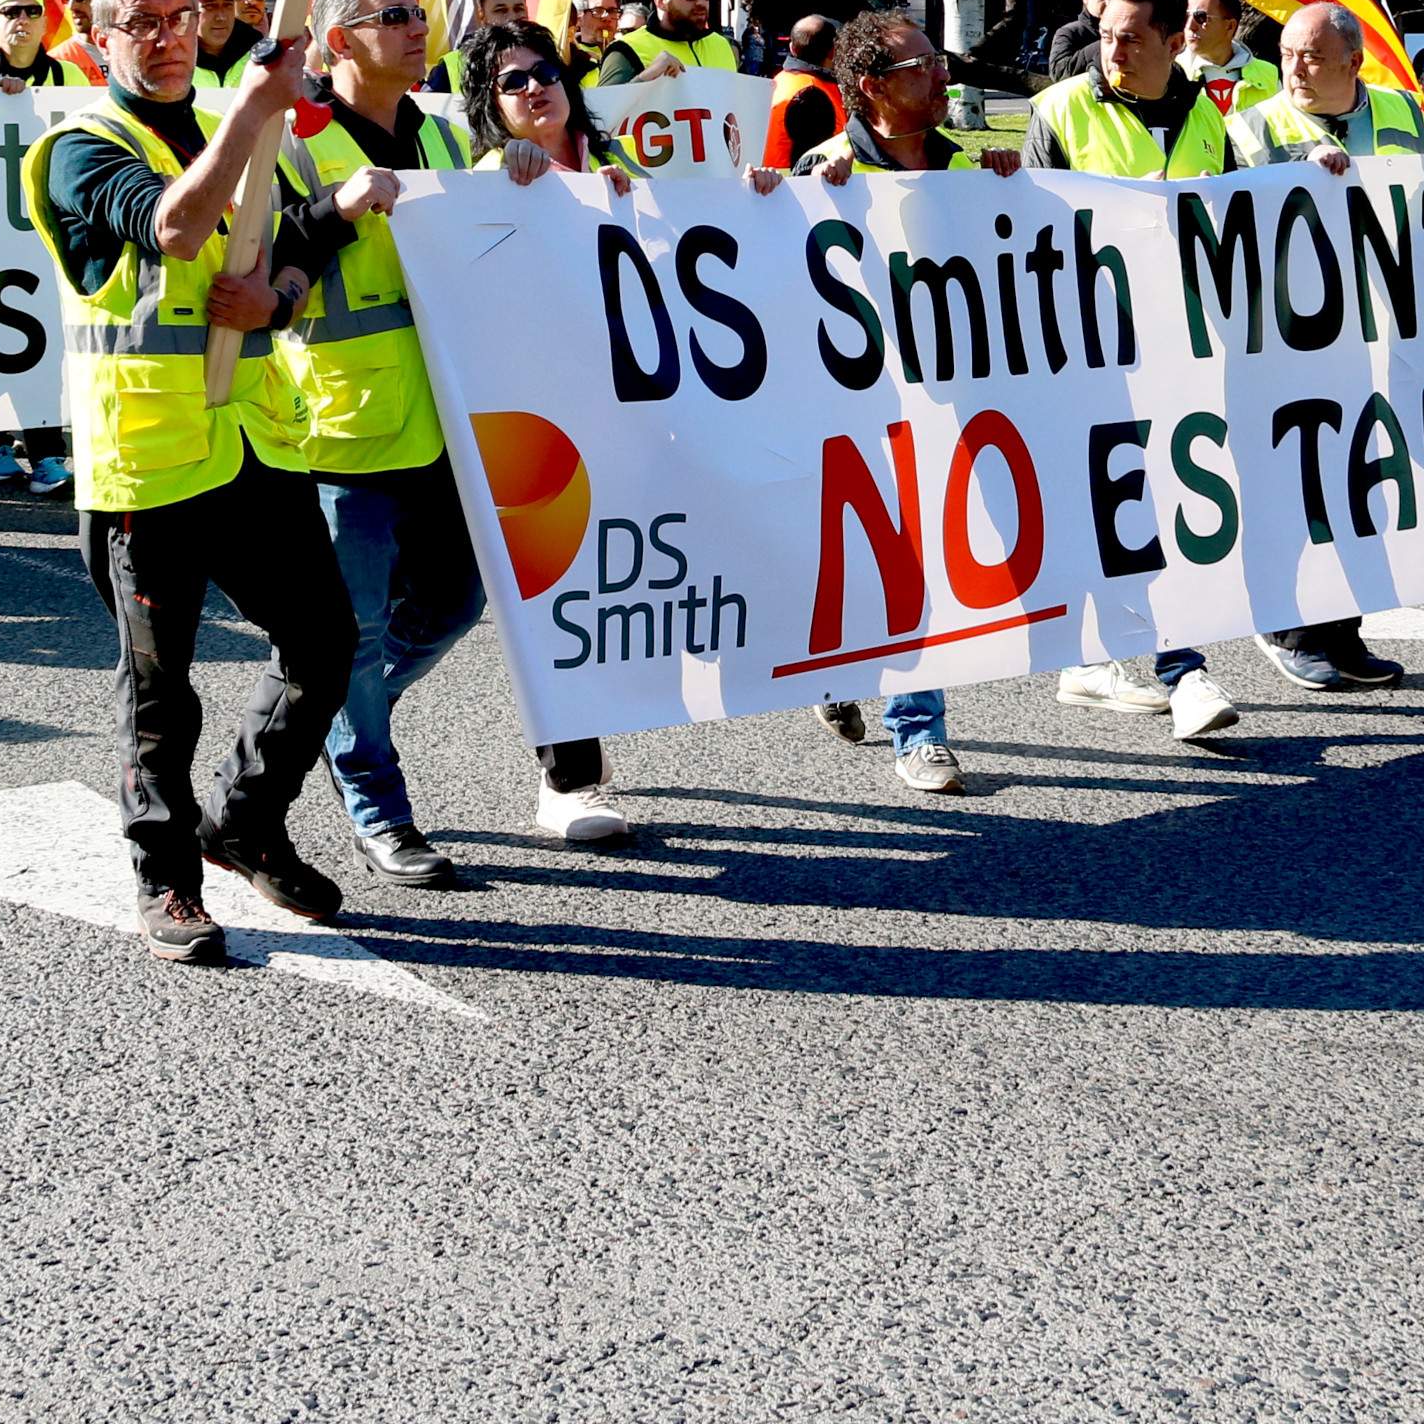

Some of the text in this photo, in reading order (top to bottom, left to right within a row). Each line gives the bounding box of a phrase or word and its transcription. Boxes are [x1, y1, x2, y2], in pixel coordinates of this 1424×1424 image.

[619, 108, 713, 168] GT
[598, 223, 768, 403] DS
[805, 208, 1136, 391] Smith
[598, 513, 688, 594] DS
[808, 409, 1044, 655] NO
[1089, 412, 1239, 579] ES
[552, 576, 748, 670] Smith
